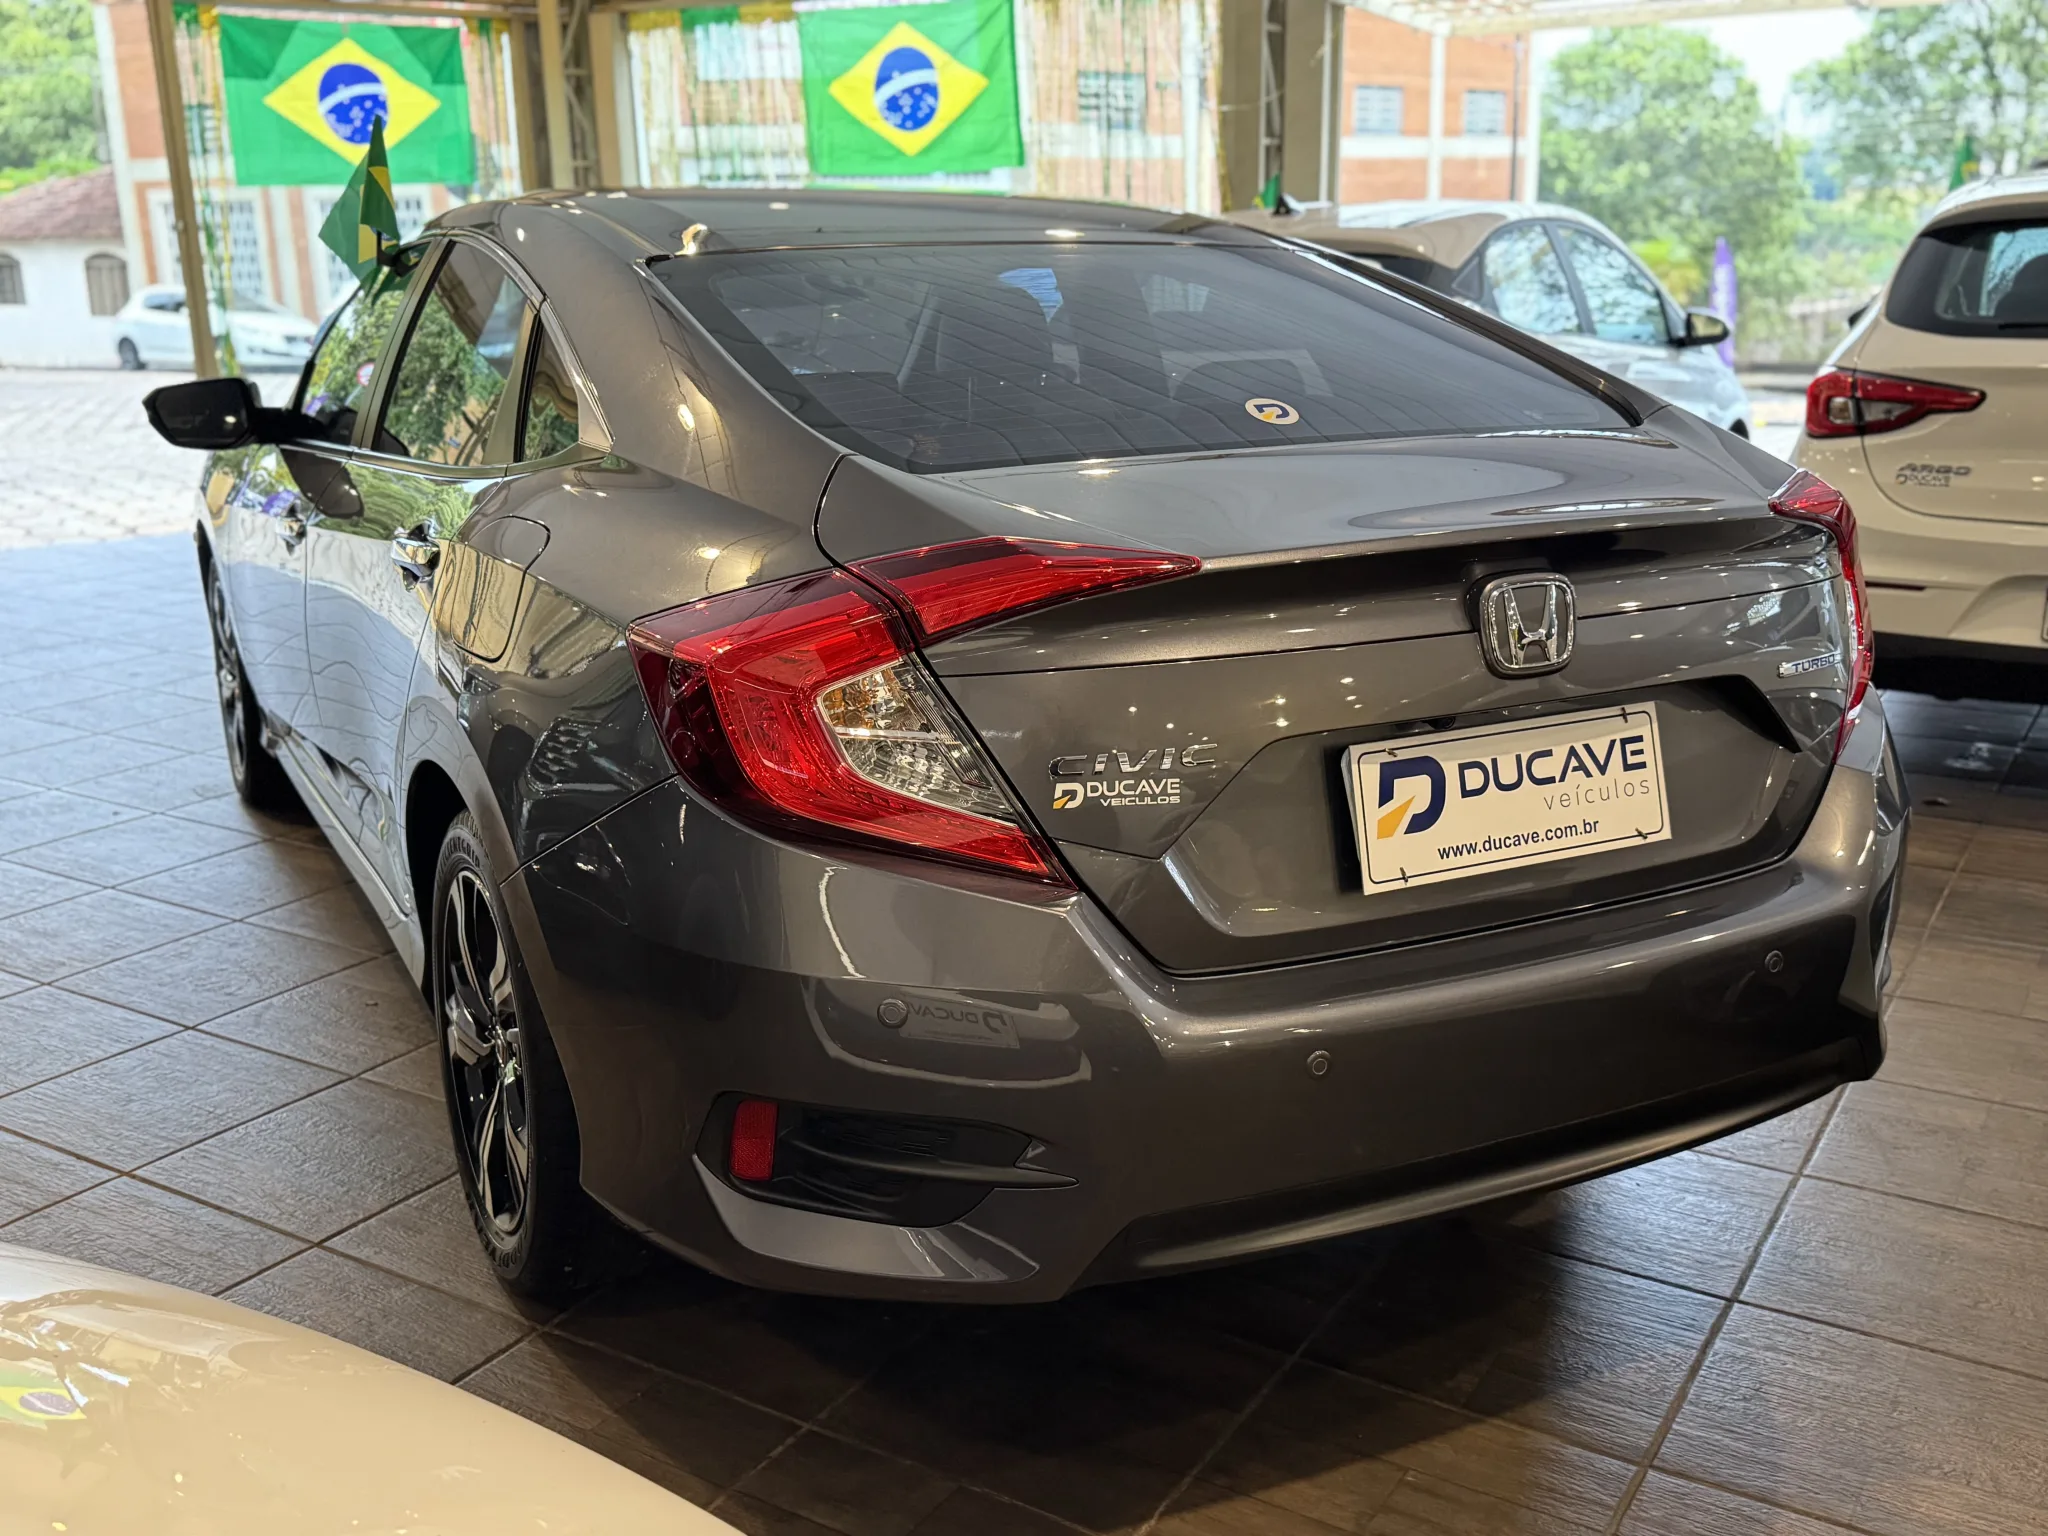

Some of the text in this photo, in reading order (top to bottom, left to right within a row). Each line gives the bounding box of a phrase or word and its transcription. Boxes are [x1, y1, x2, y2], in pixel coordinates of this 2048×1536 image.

[1897, 462, 1972, 477] ARGO
[1791, 653, 1836, 674] TURBO
[1048, 743, 1218, 778] CIVIC
[1457, 734, 1647, 799] DUCAVE
[1086, 778, 1181, 798] DUCAVE
[1099, 795, 1181, 807] VEICULOS
[1542, 776, 1651, 811] veículos
[1437, 818, 1600, 861] www.ducave.com.br
